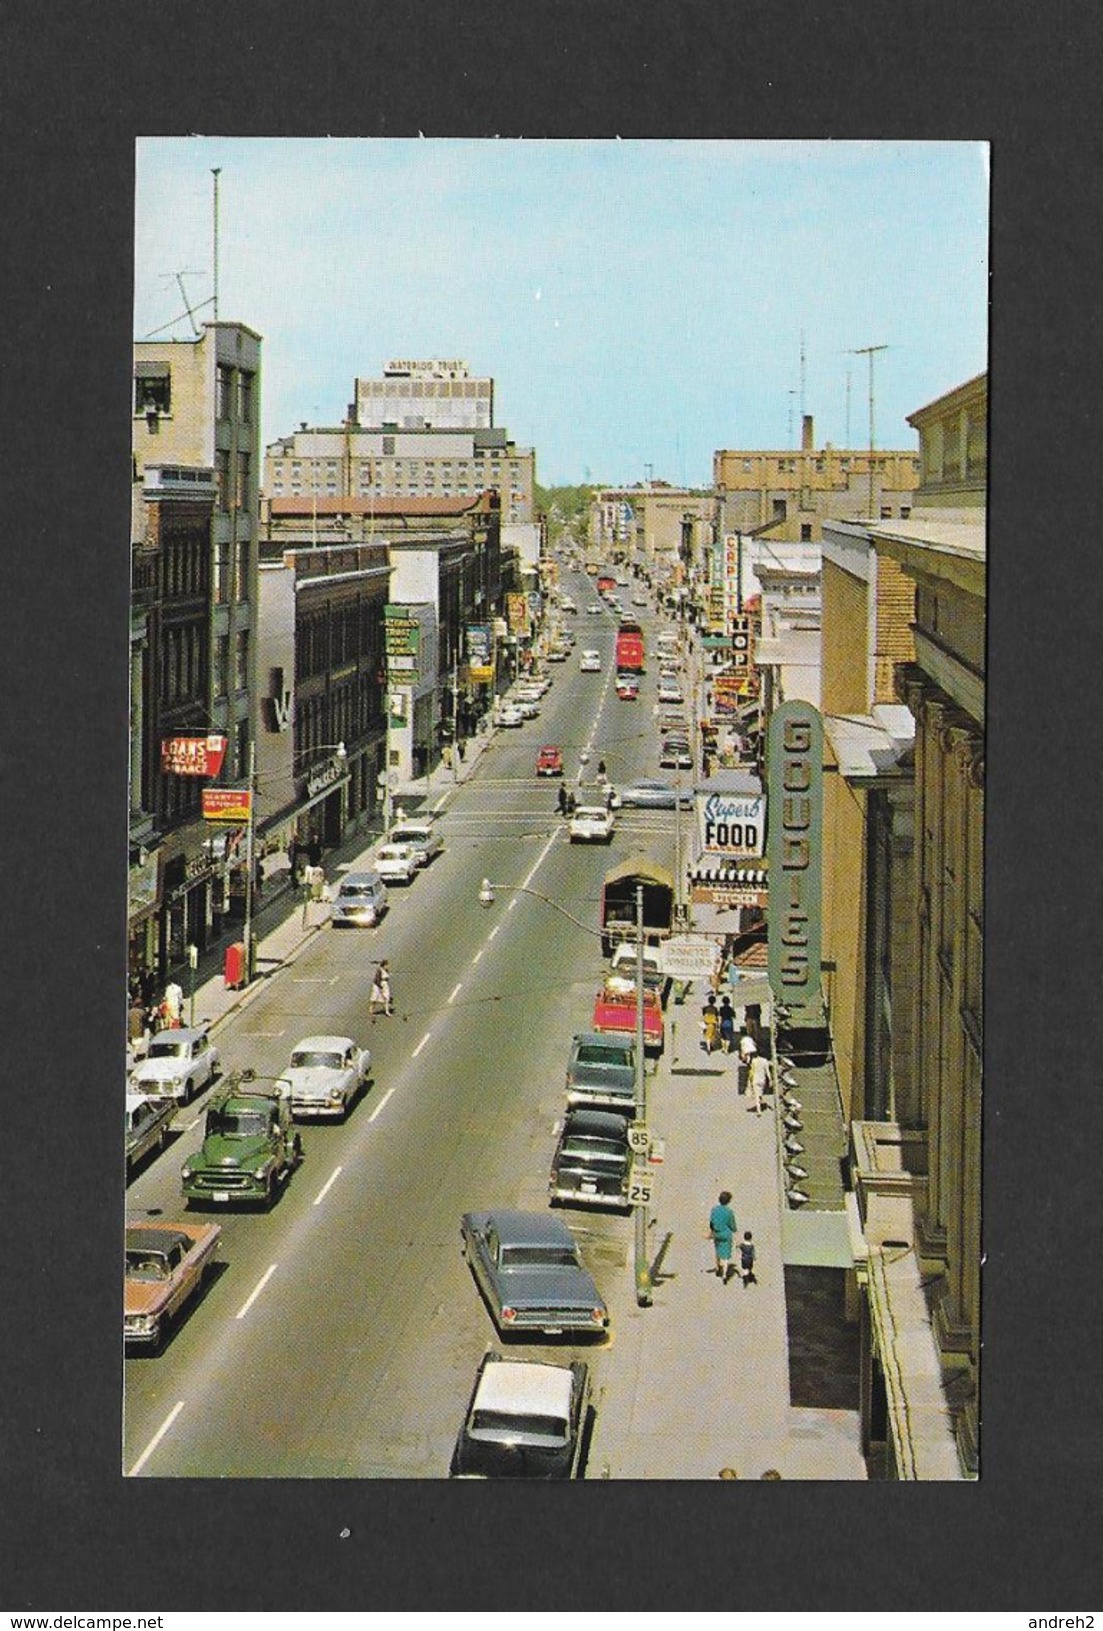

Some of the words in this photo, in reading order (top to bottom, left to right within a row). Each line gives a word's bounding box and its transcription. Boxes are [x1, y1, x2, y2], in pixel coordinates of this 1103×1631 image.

[389, 361, 433, 370] WATERLOO
[438, 361, 464, 371] TRUST
[726, 536, 737, 636] CAPITOL
[161, 740, 205, 756] LOANS
[704, 793, 762, 822] Superb
[705, 821, 757, 847] FOOD
[783, 719, 811, 985] GOUDIES
[631, 1133, 648, 1146] 85
[631, 1187, 650, 1202] 25
